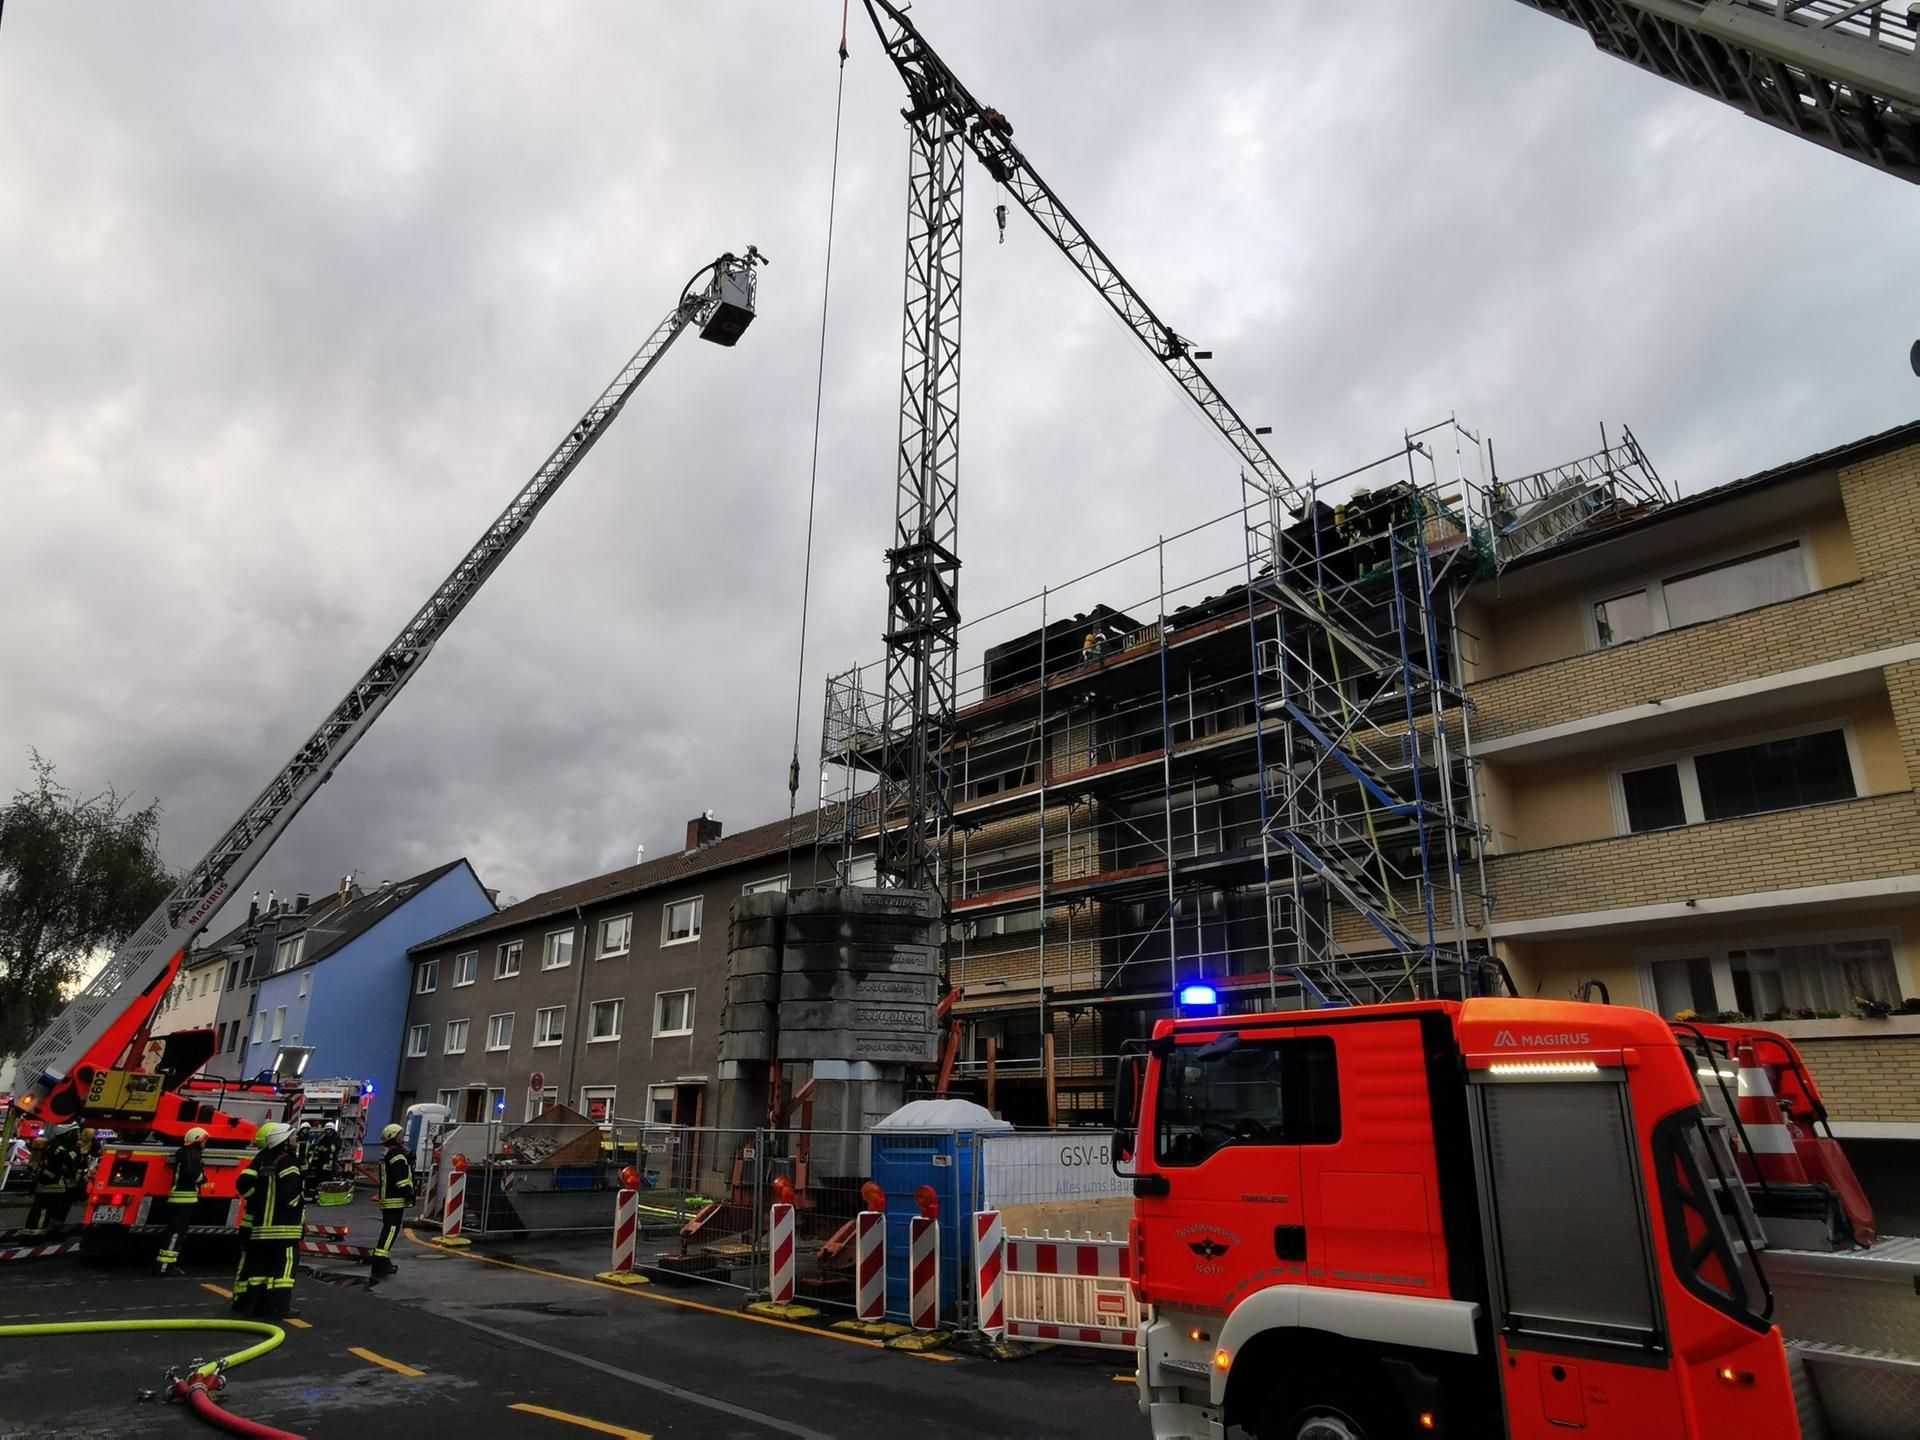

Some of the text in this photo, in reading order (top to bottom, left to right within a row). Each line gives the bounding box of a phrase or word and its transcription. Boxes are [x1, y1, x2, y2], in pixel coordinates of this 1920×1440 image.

[188, 882, 229, 926] MAGIRUS
[1521, 1032, 1591, 1047] MAGIRUS
[89, 1072, 107, 1102] 6602
[1060, 1145, 1131, 1166] GSV-B
[1056, 1181, 1081, 1194] Alles
[1084, 1181, 1107, 1193] ums
